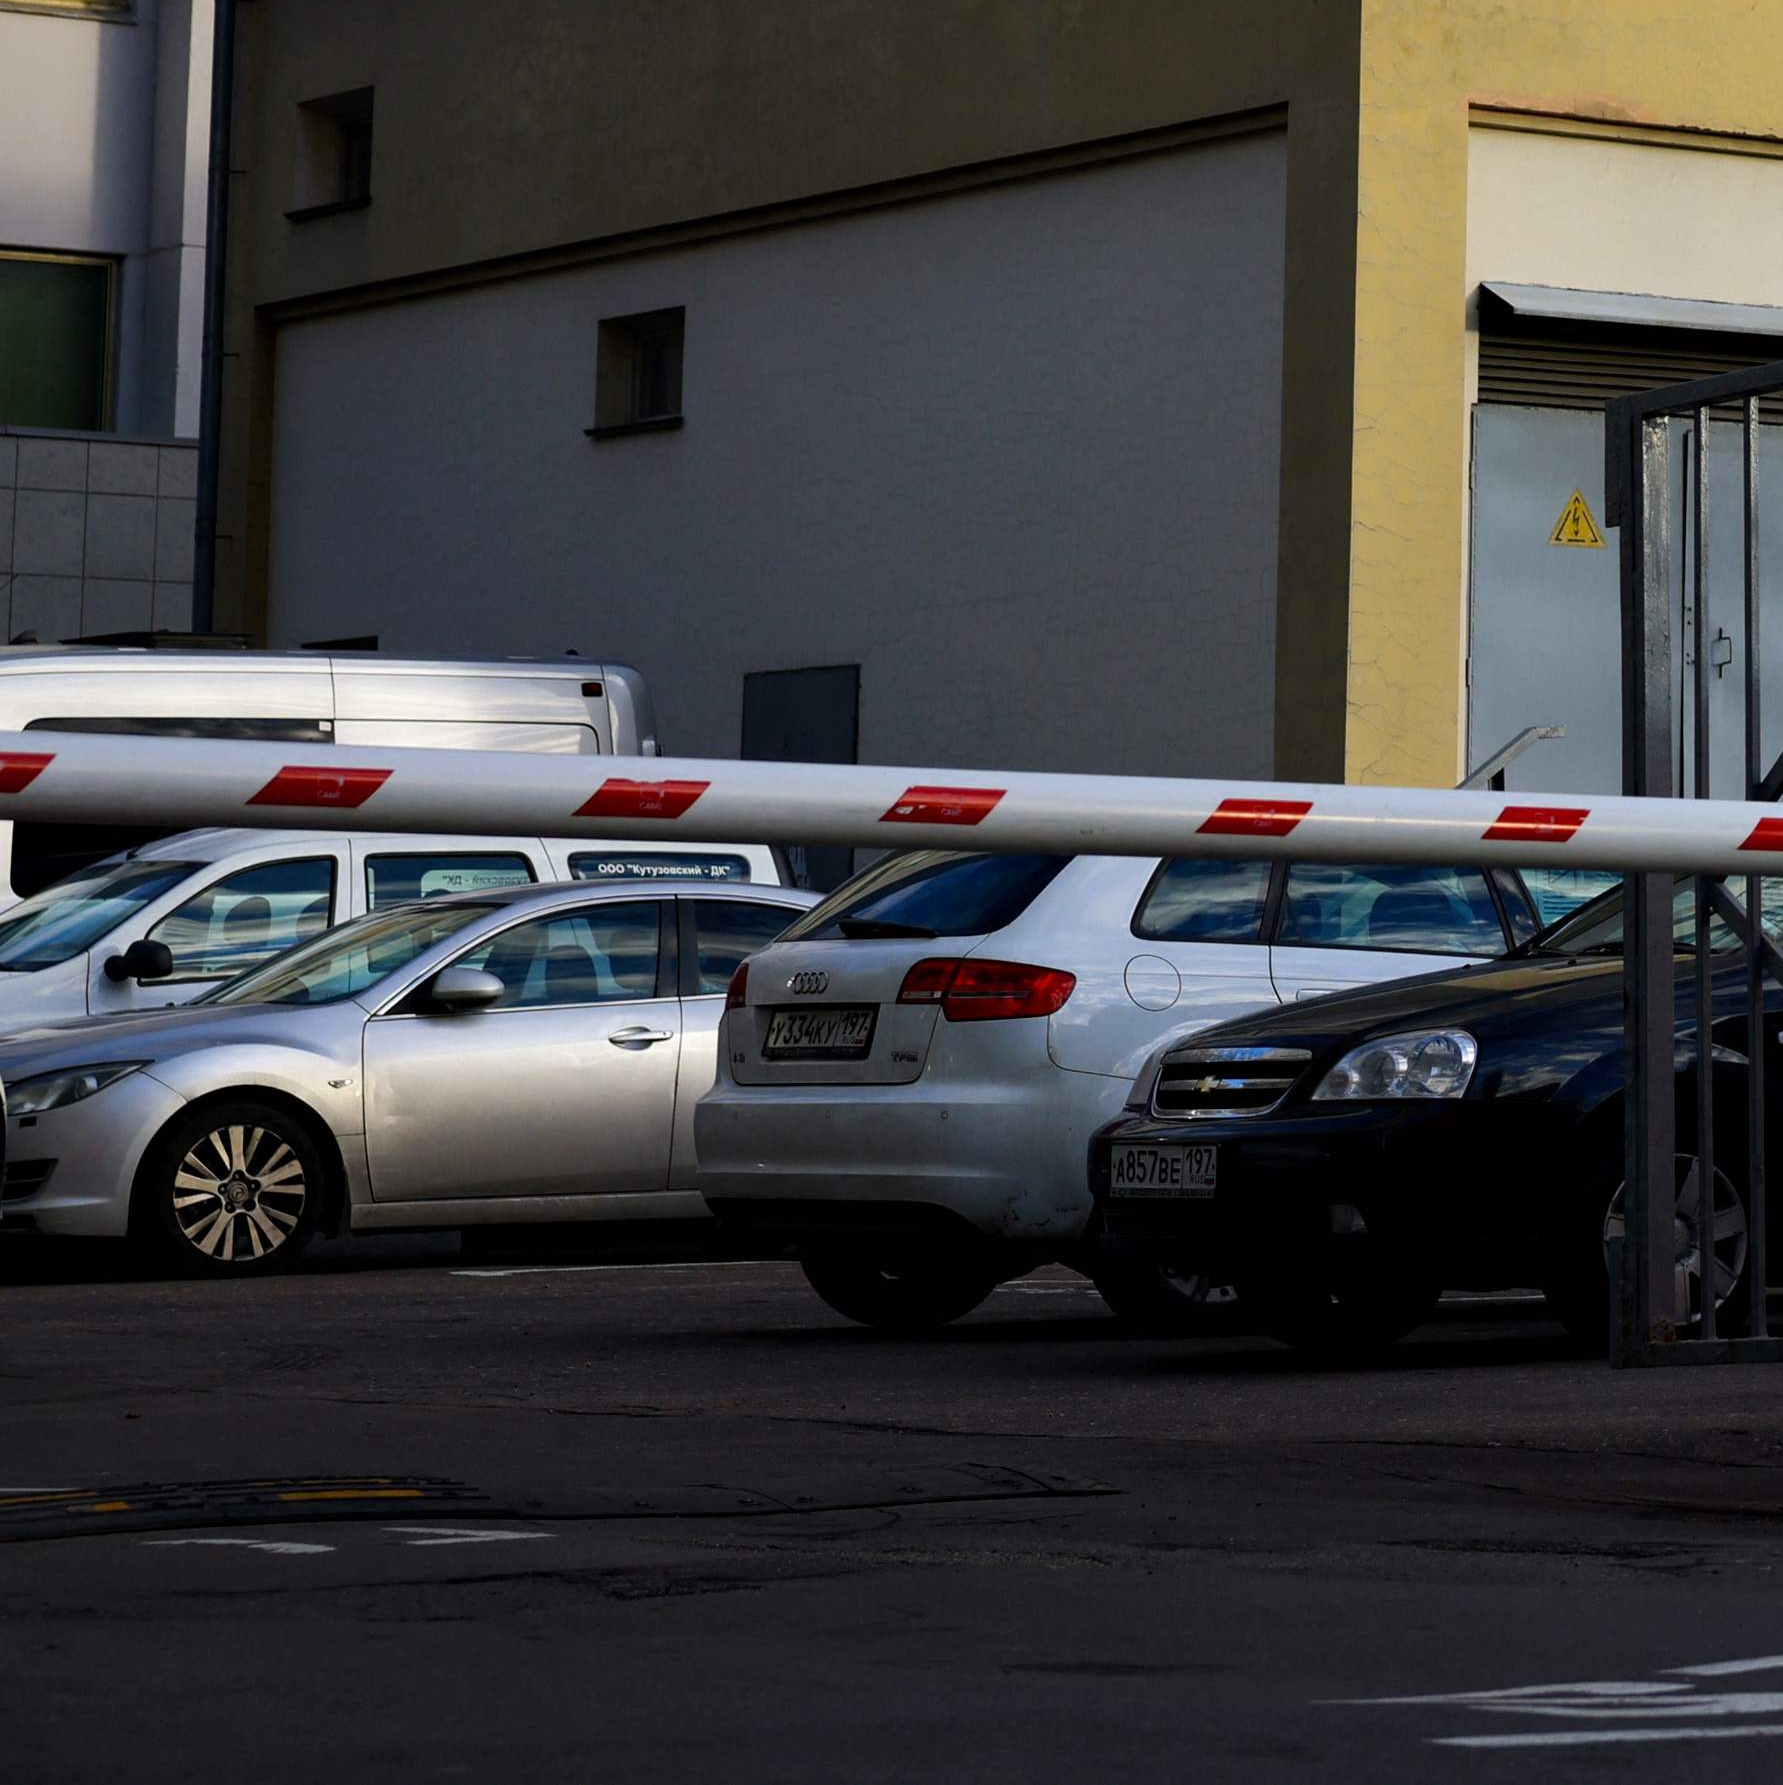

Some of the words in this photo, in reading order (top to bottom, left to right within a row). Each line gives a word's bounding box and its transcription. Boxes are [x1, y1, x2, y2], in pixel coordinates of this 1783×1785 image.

[598, 864, 625, 874] ООО
[627, 864, 702, 877] "Кутузовский
[1186, 1148, 1213, 1175] 197
